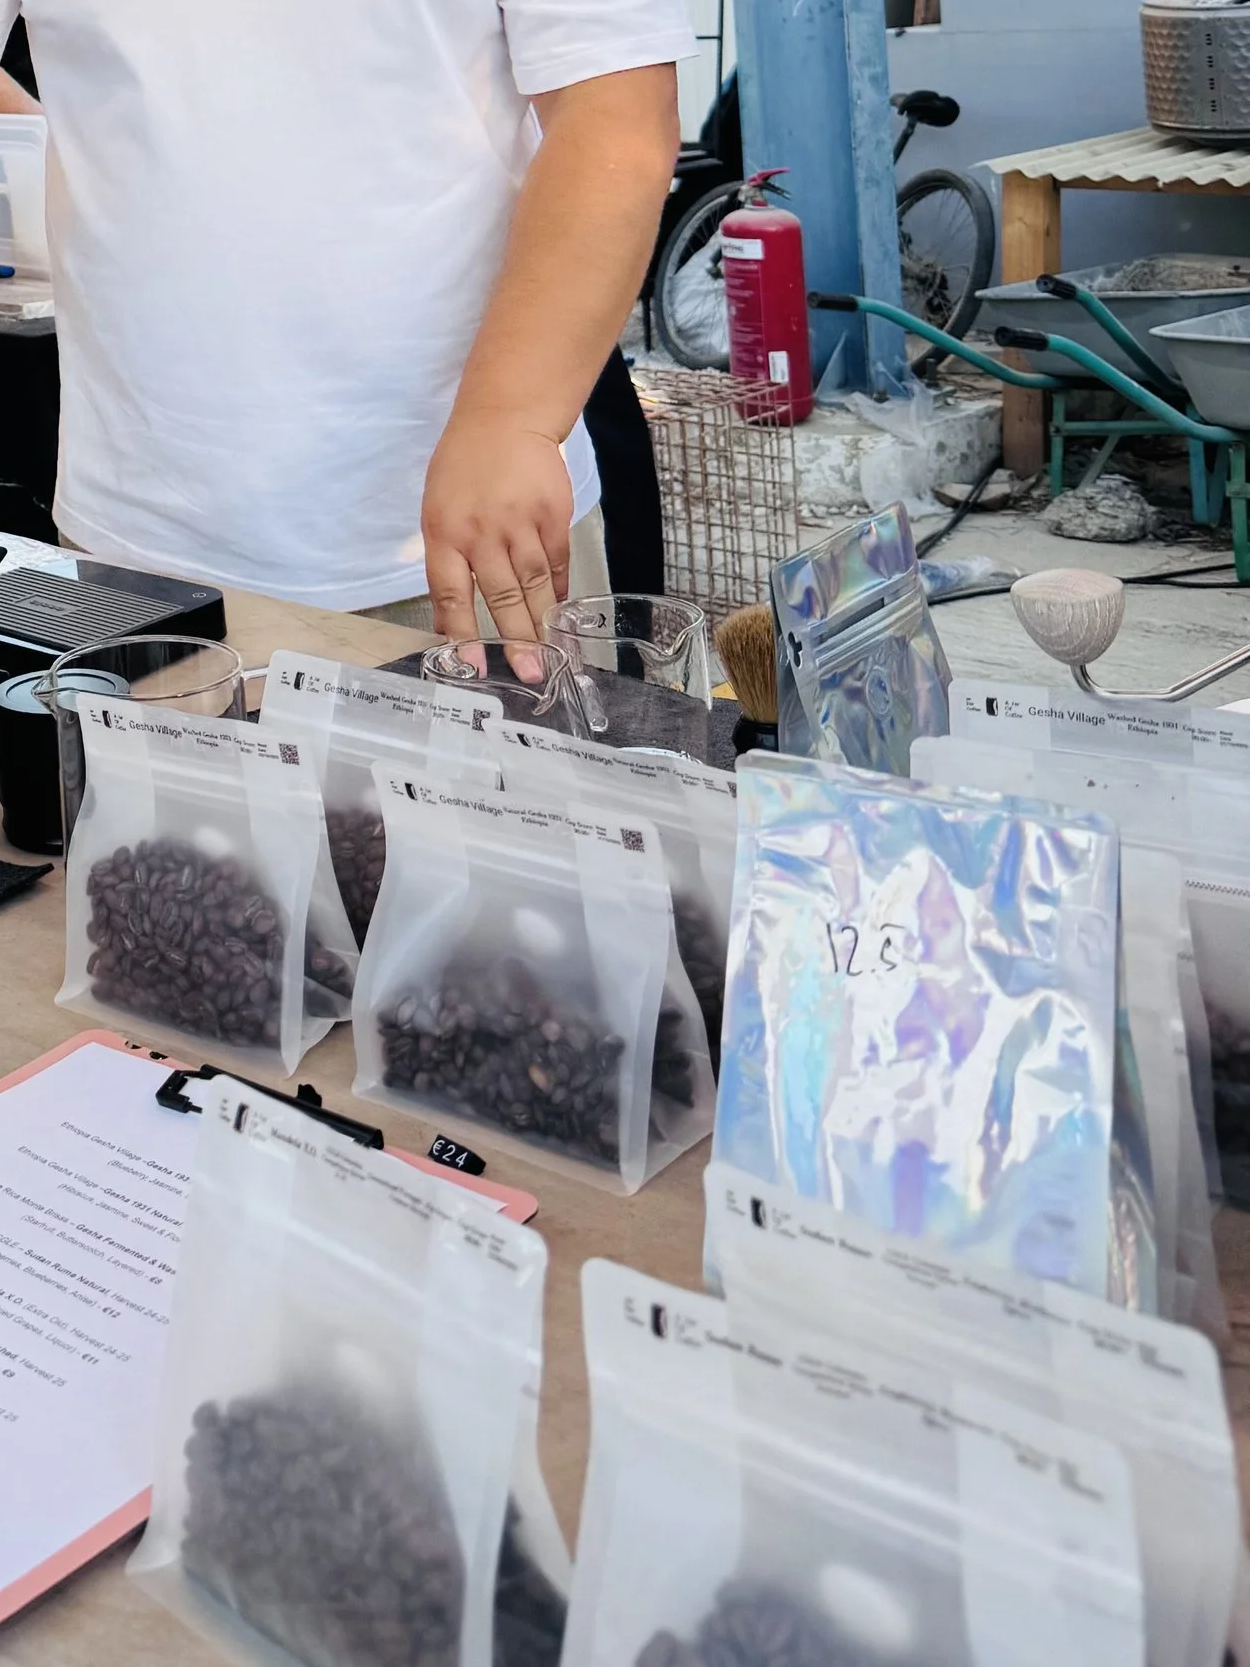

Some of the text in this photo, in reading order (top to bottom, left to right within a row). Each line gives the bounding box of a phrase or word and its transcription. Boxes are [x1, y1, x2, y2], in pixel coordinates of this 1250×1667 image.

[324, 683, 350, 697] Gesha
[351, 688, 380, 704] Village
[1028, 706, 1065, 721] Gesha
[1067, 710, 1106, 726] Village
[129, 720, 182, 738] Gesha Village
[551, 743, 614, 767] Gesha Village
[439, 794, 470, 809] Gesha
[470, 800, 503, 817] Village
[61, 1121, 142, 1162] Ethiopia Gesha Village
[432, 1139, 468, 1168] €24
[18, 1145, 151, 1212] Ethiopia Gesha Village 1931
[3, 1187, 21, 1200] Rica
[20, 1196, 45, 1212] Monte
[76, 1223, 103, 1240] Gesha
[102, 1236, 151, 1262] Fermented
[131, 1217, 157, 1232] Sweet
[158, 1228, 166, 1236] &
[24, 1249, 52, 1266] Sudan
[51, 1262, 77, 1278] Rume
[111, 1293, 145, 1313] Harvest
[102, 1306, 121, 1319] €12
[70, 1327, 105, 1349] Harvest
[19, 1357, 54, 1380] Harvest
